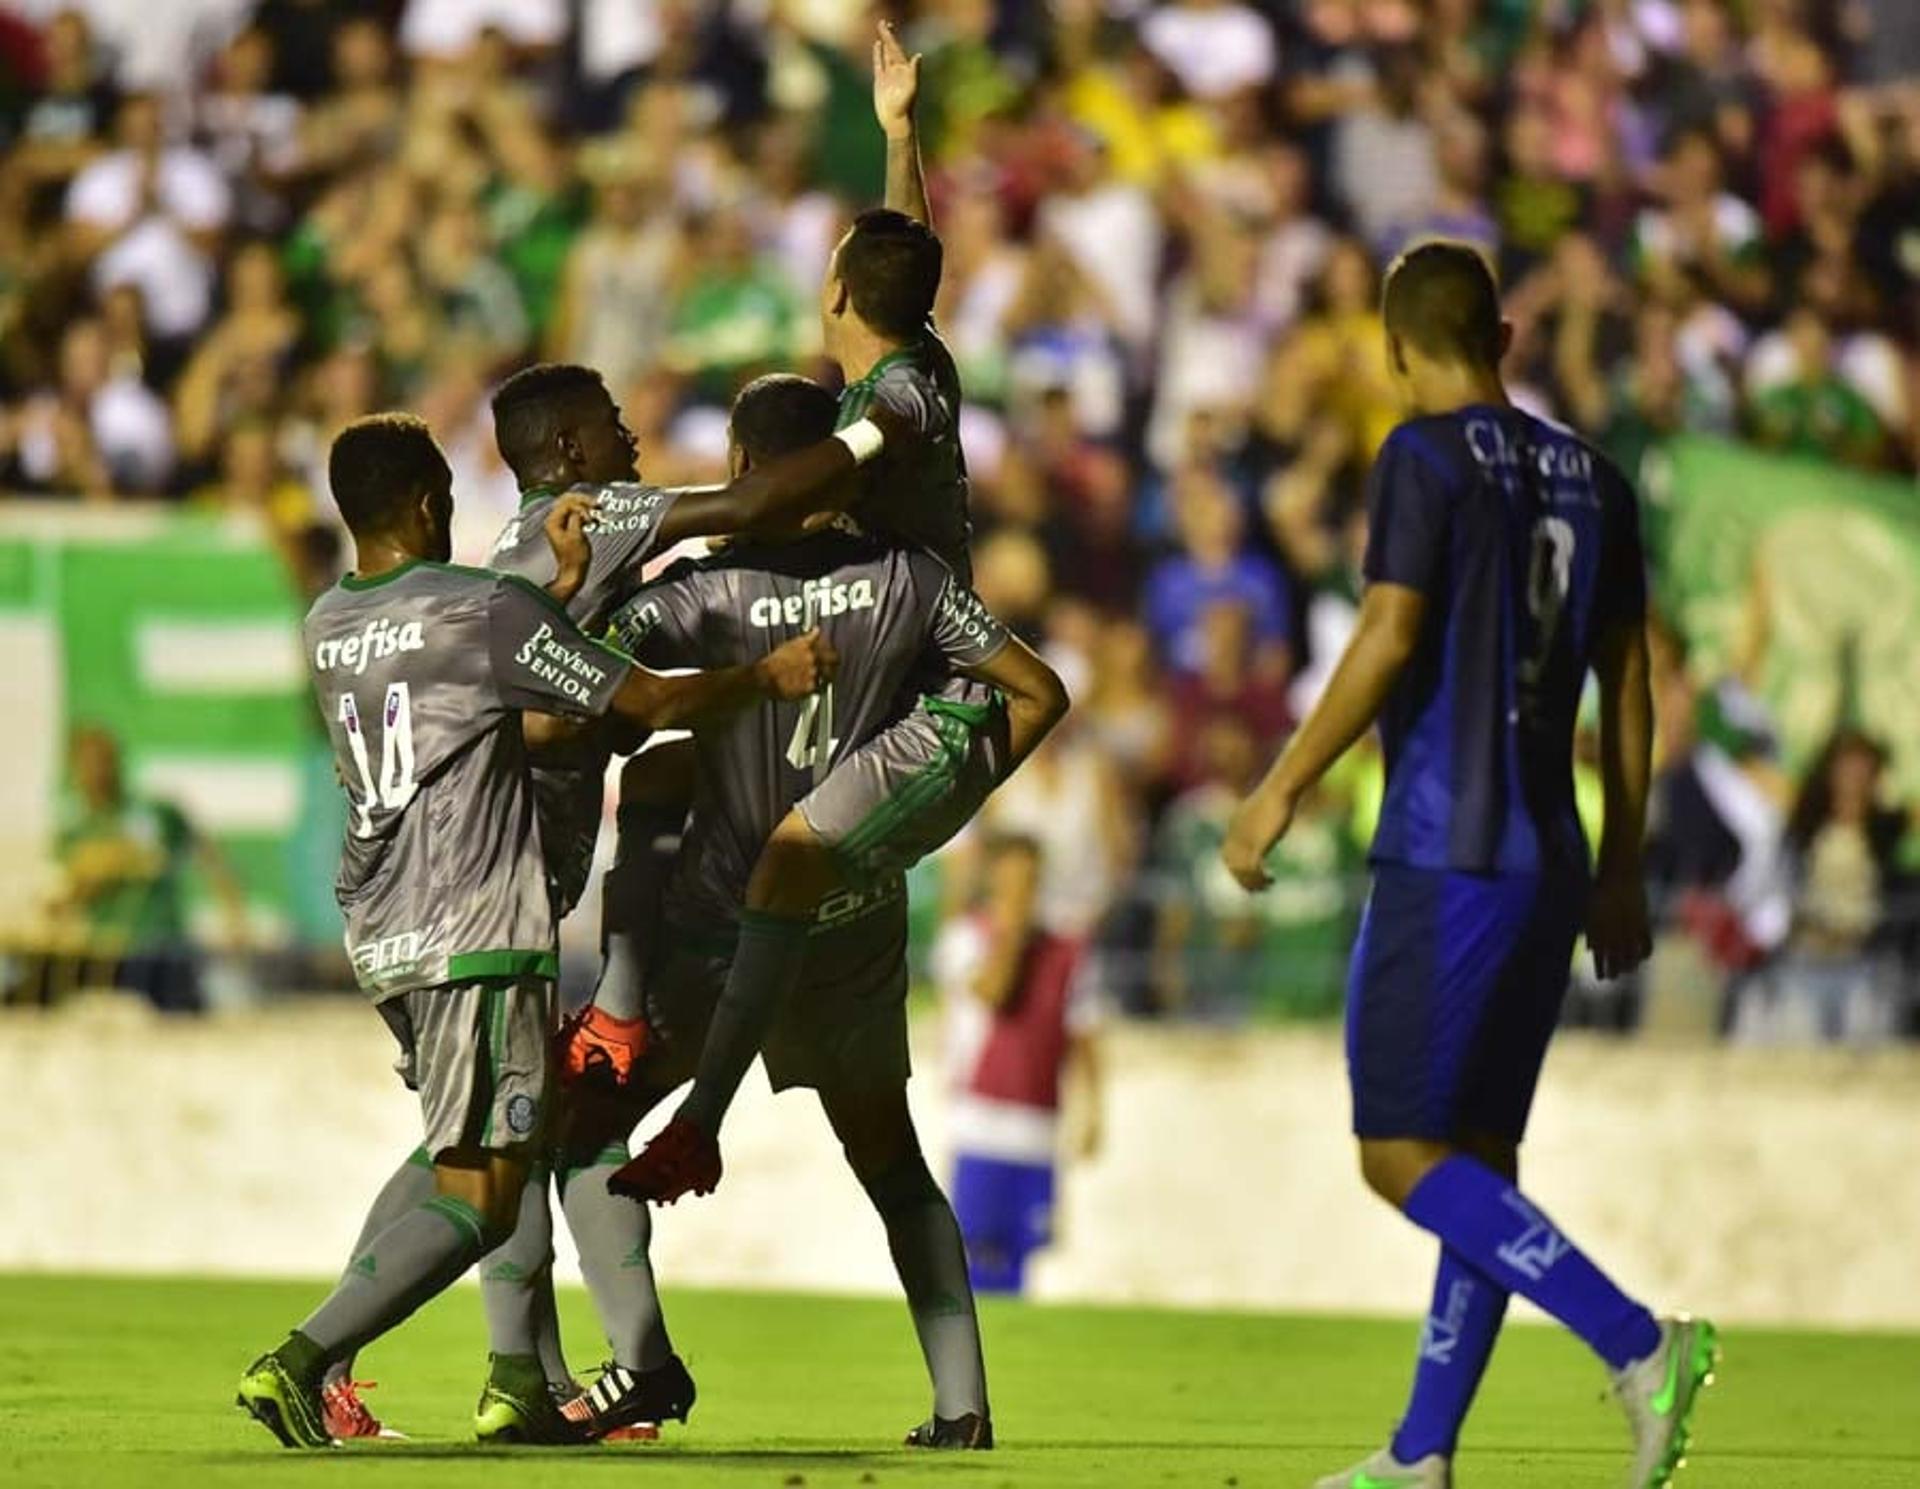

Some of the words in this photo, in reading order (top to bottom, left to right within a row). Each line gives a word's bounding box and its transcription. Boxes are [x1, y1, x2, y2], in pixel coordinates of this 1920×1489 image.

[750, 577, 875, 632] crefisa
[315, 617, 425, 675] crefisa
[514, 641, 591, 706] SENIOR
[530, 622, 607, 686] PREVENT
[338, 681, 419, 839] 14
